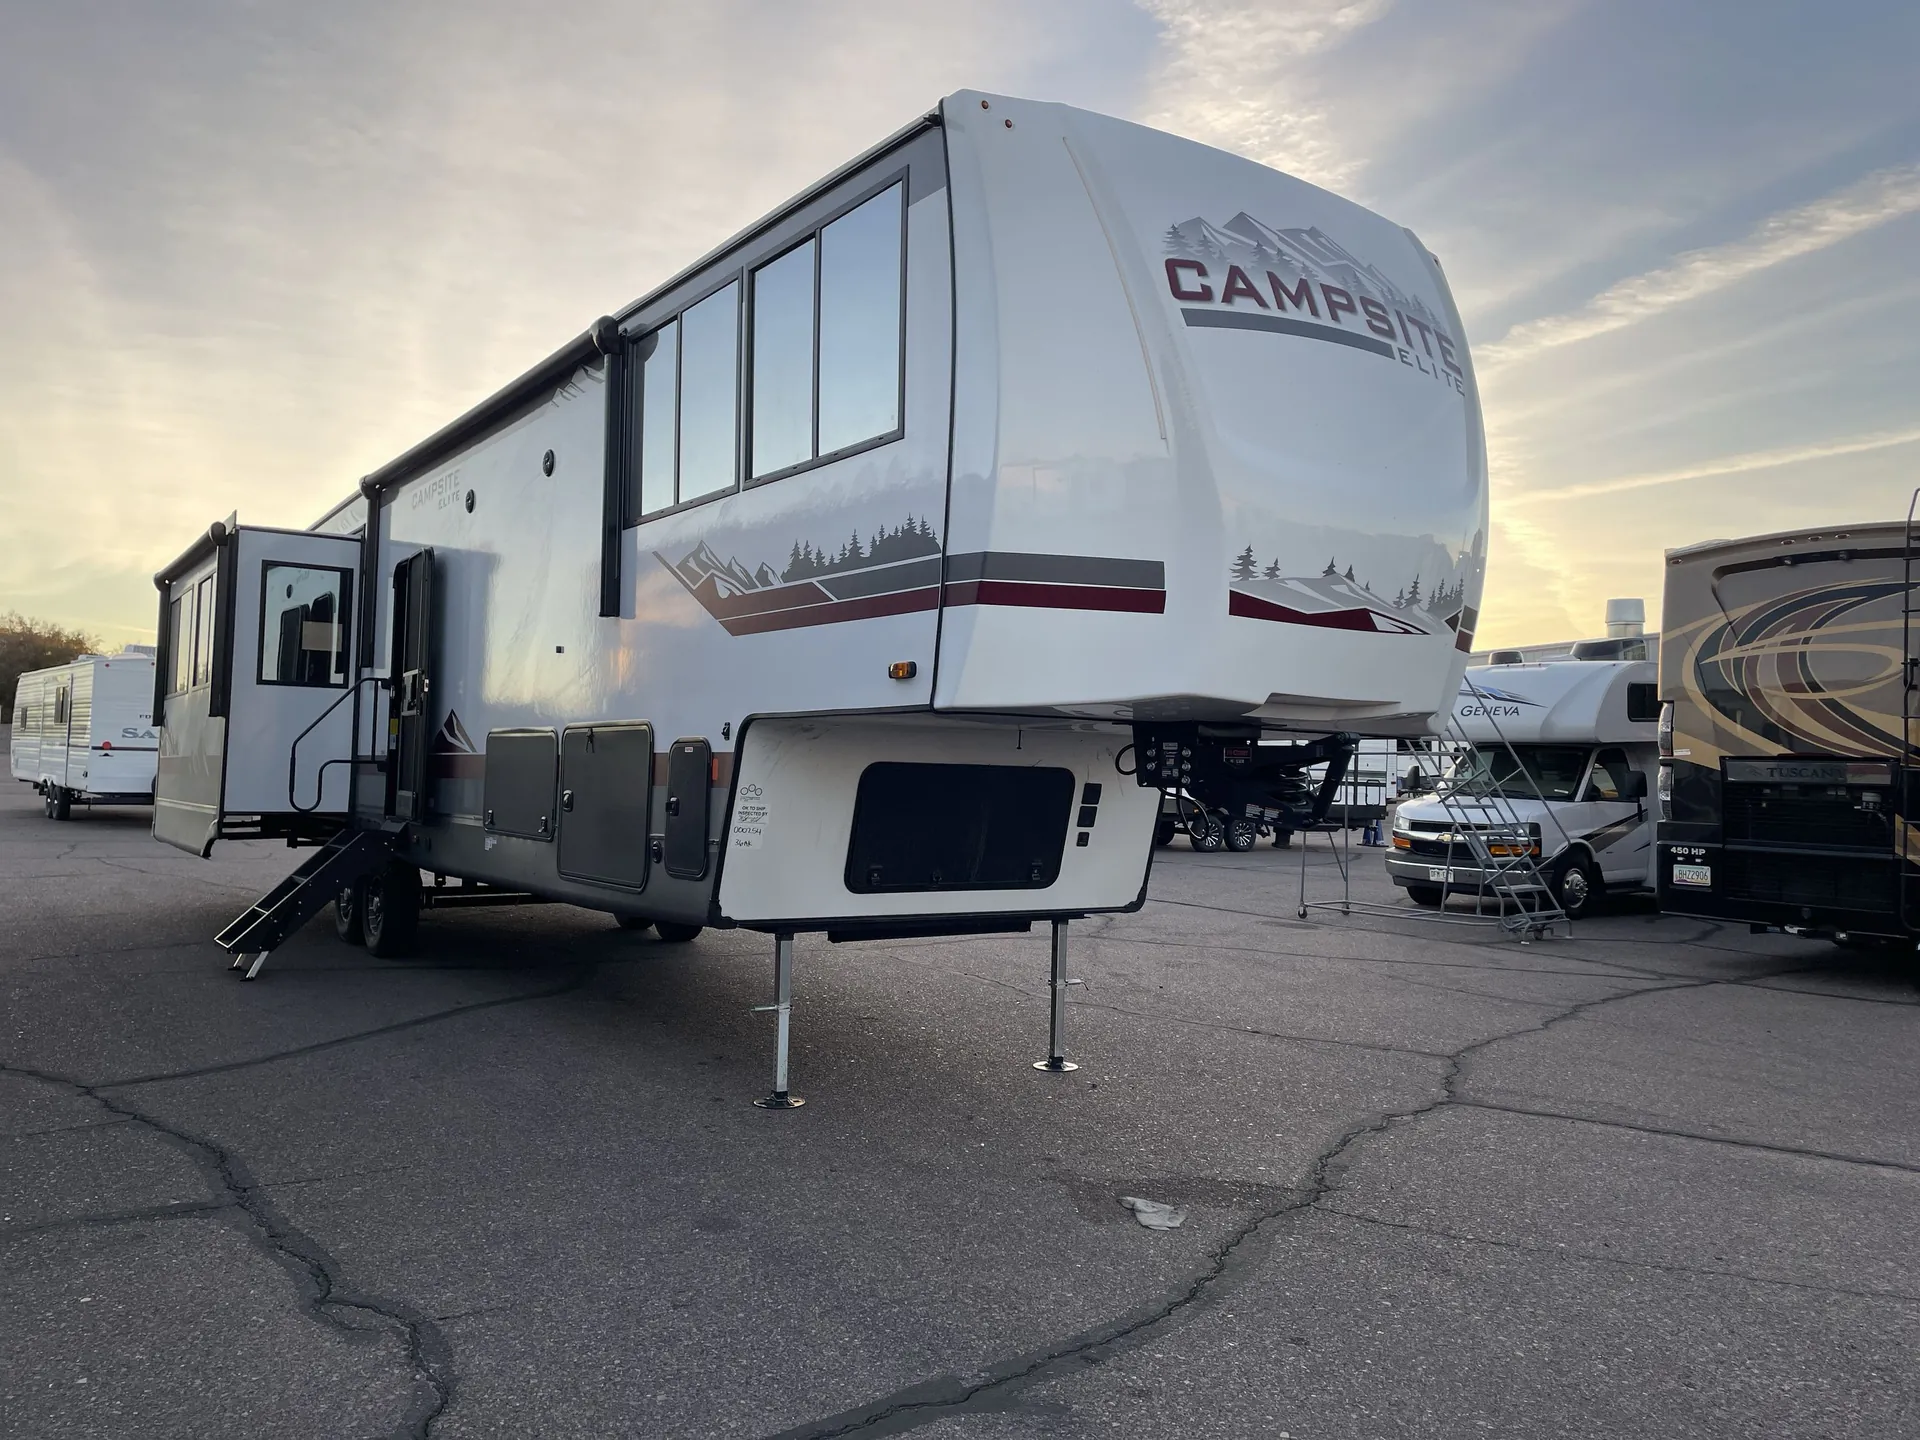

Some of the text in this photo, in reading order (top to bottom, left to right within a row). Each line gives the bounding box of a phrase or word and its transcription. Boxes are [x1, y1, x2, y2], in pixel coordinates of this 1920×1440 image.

[1164, 257, 1464, 378] CAMPSITE
[1396, 346, 1466, 397] ELITE
[411, 469, 460, 511] CAMPSITE
[437, 489, 460, 511] ELITE
[1460, 705, 1520, 717] GENEVA
[1670, 846, 1706, 856] 450 HP
